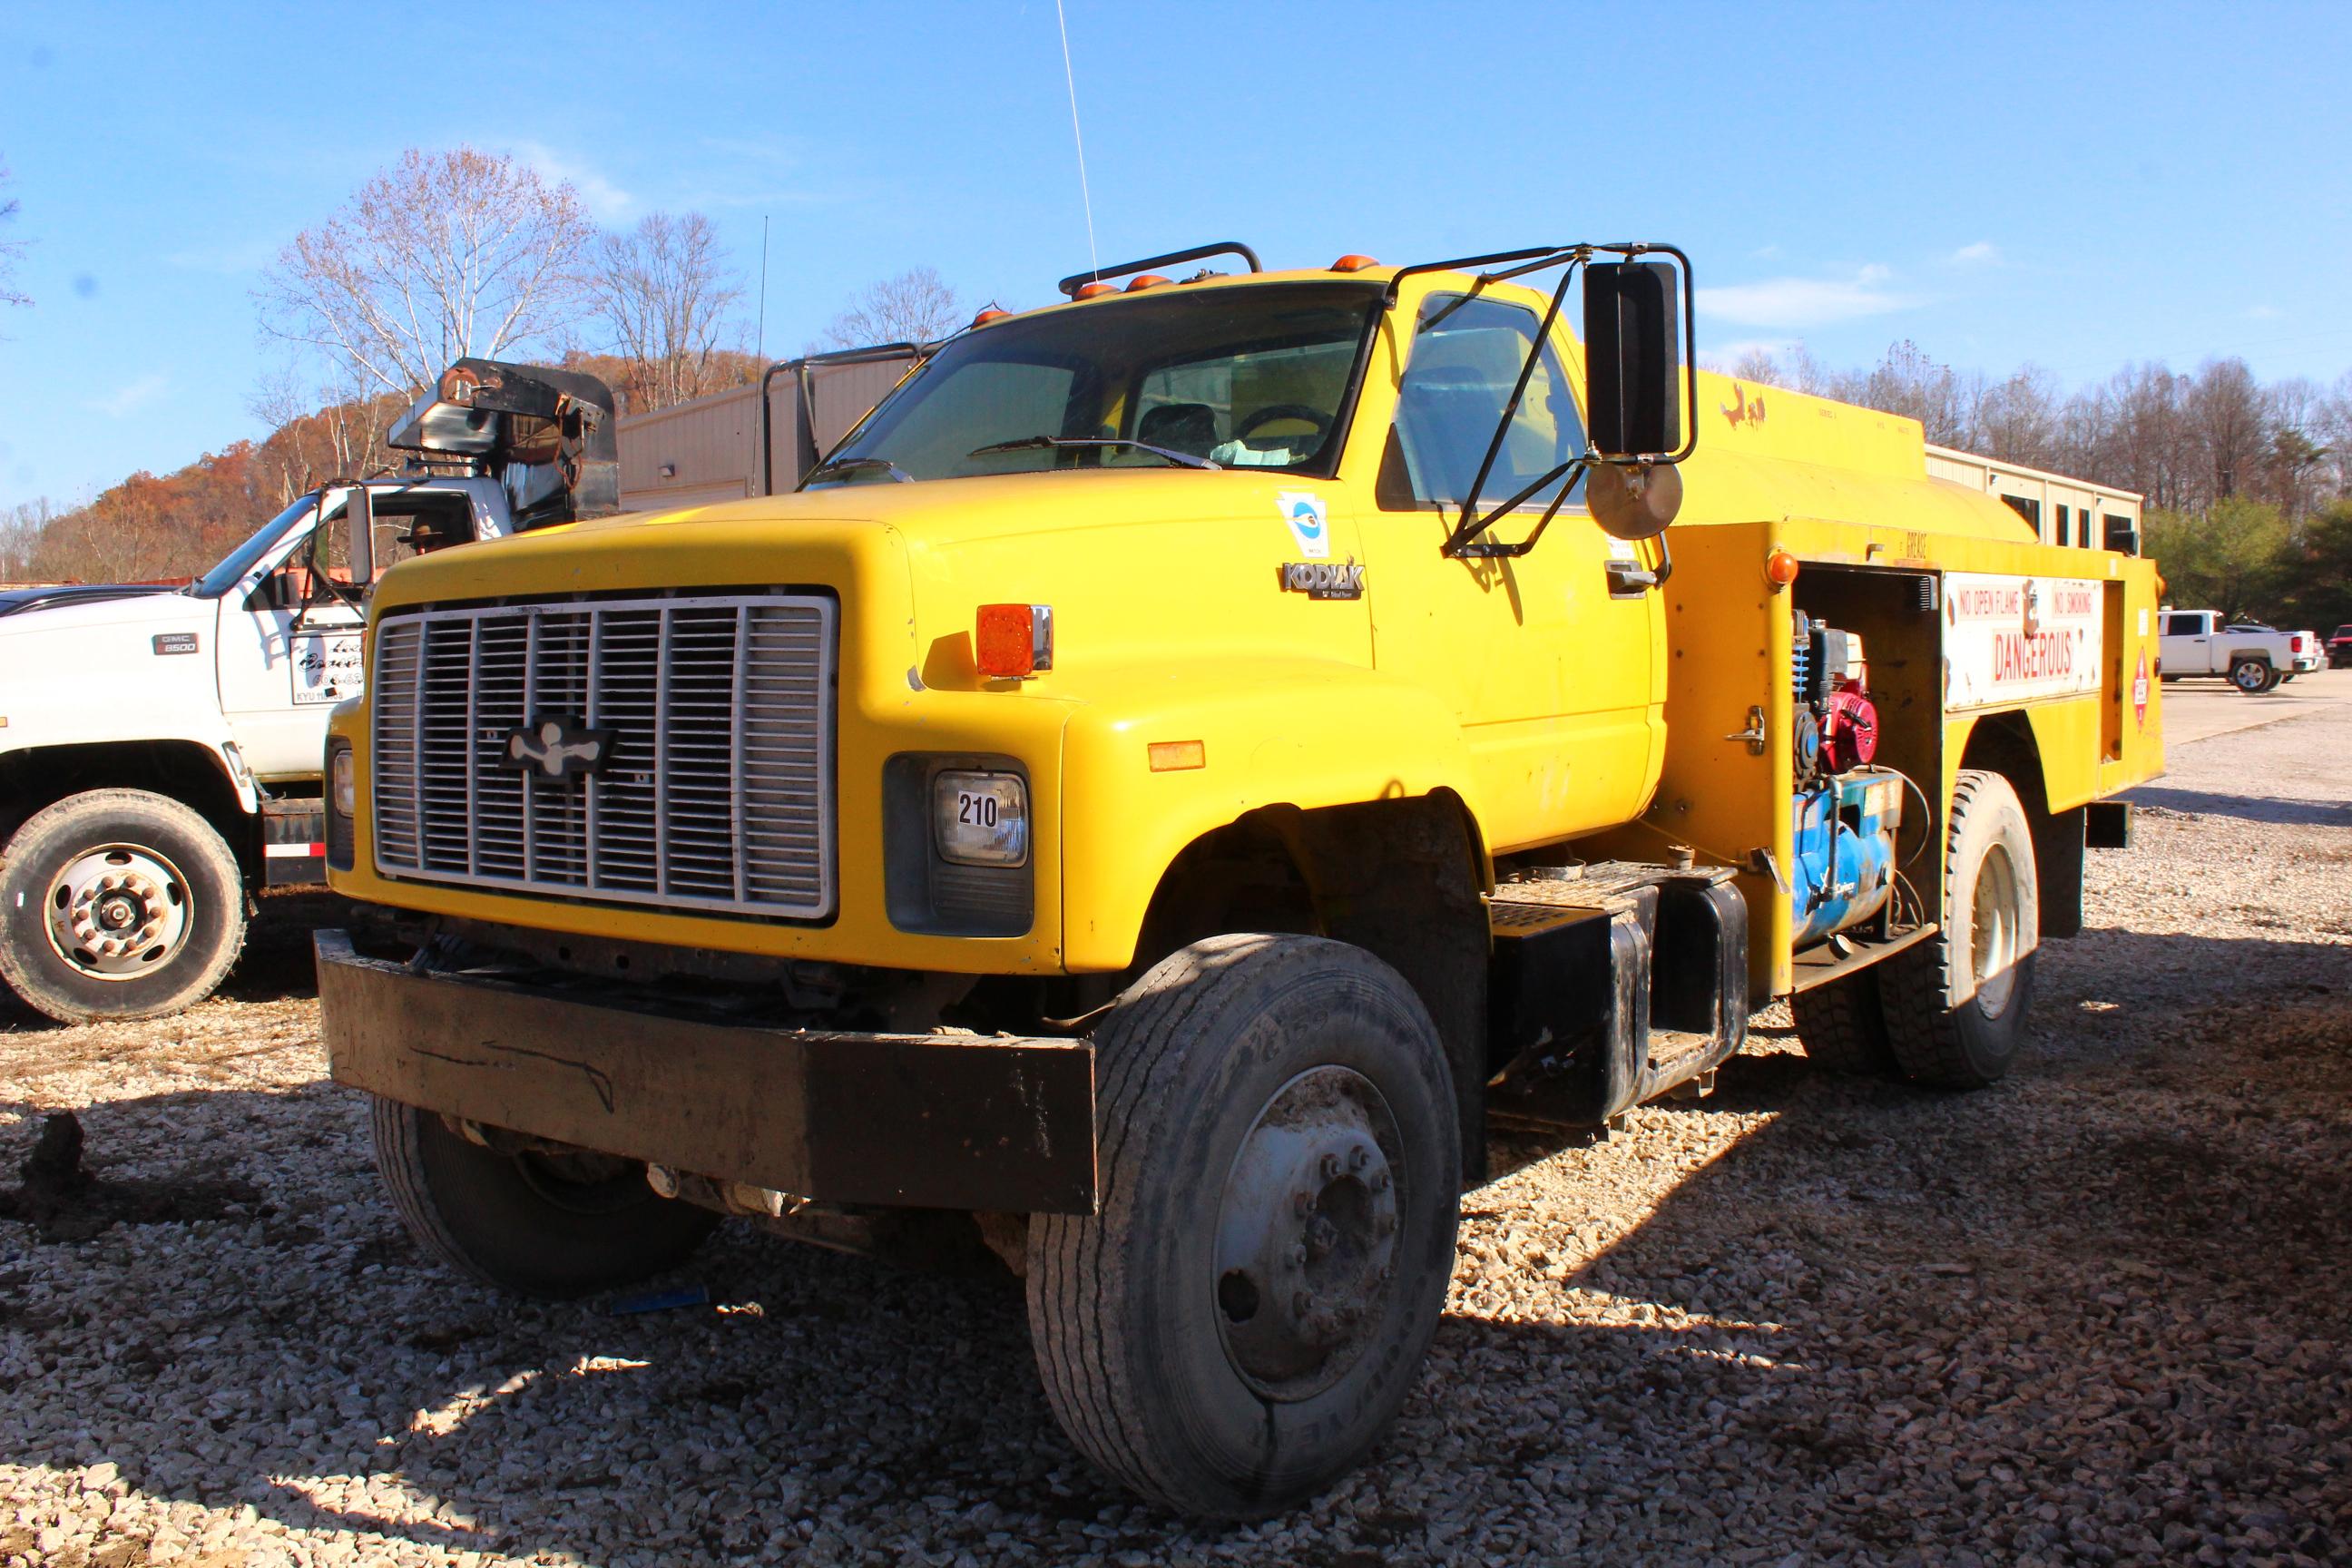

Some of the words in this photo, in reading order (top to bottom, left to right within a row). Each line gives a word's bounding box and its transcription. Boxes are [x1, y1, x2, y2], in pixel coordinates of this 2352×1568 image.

[1283, 563, 1365, 591] KODIAK
[1960, 590, 1970, 615] NO
[1975, 590, 1994, 615] OPEN
[1996, 590, 2018, 614] FLAME
[2054, 593, 2063, 613] NO
[2067, 593, 2091, 613] SMOKING
[165, 643, 196, 652] 8500
[1994, 631, 2072, 681] DANGEROUS
[959, 794, 997, 828] 210
